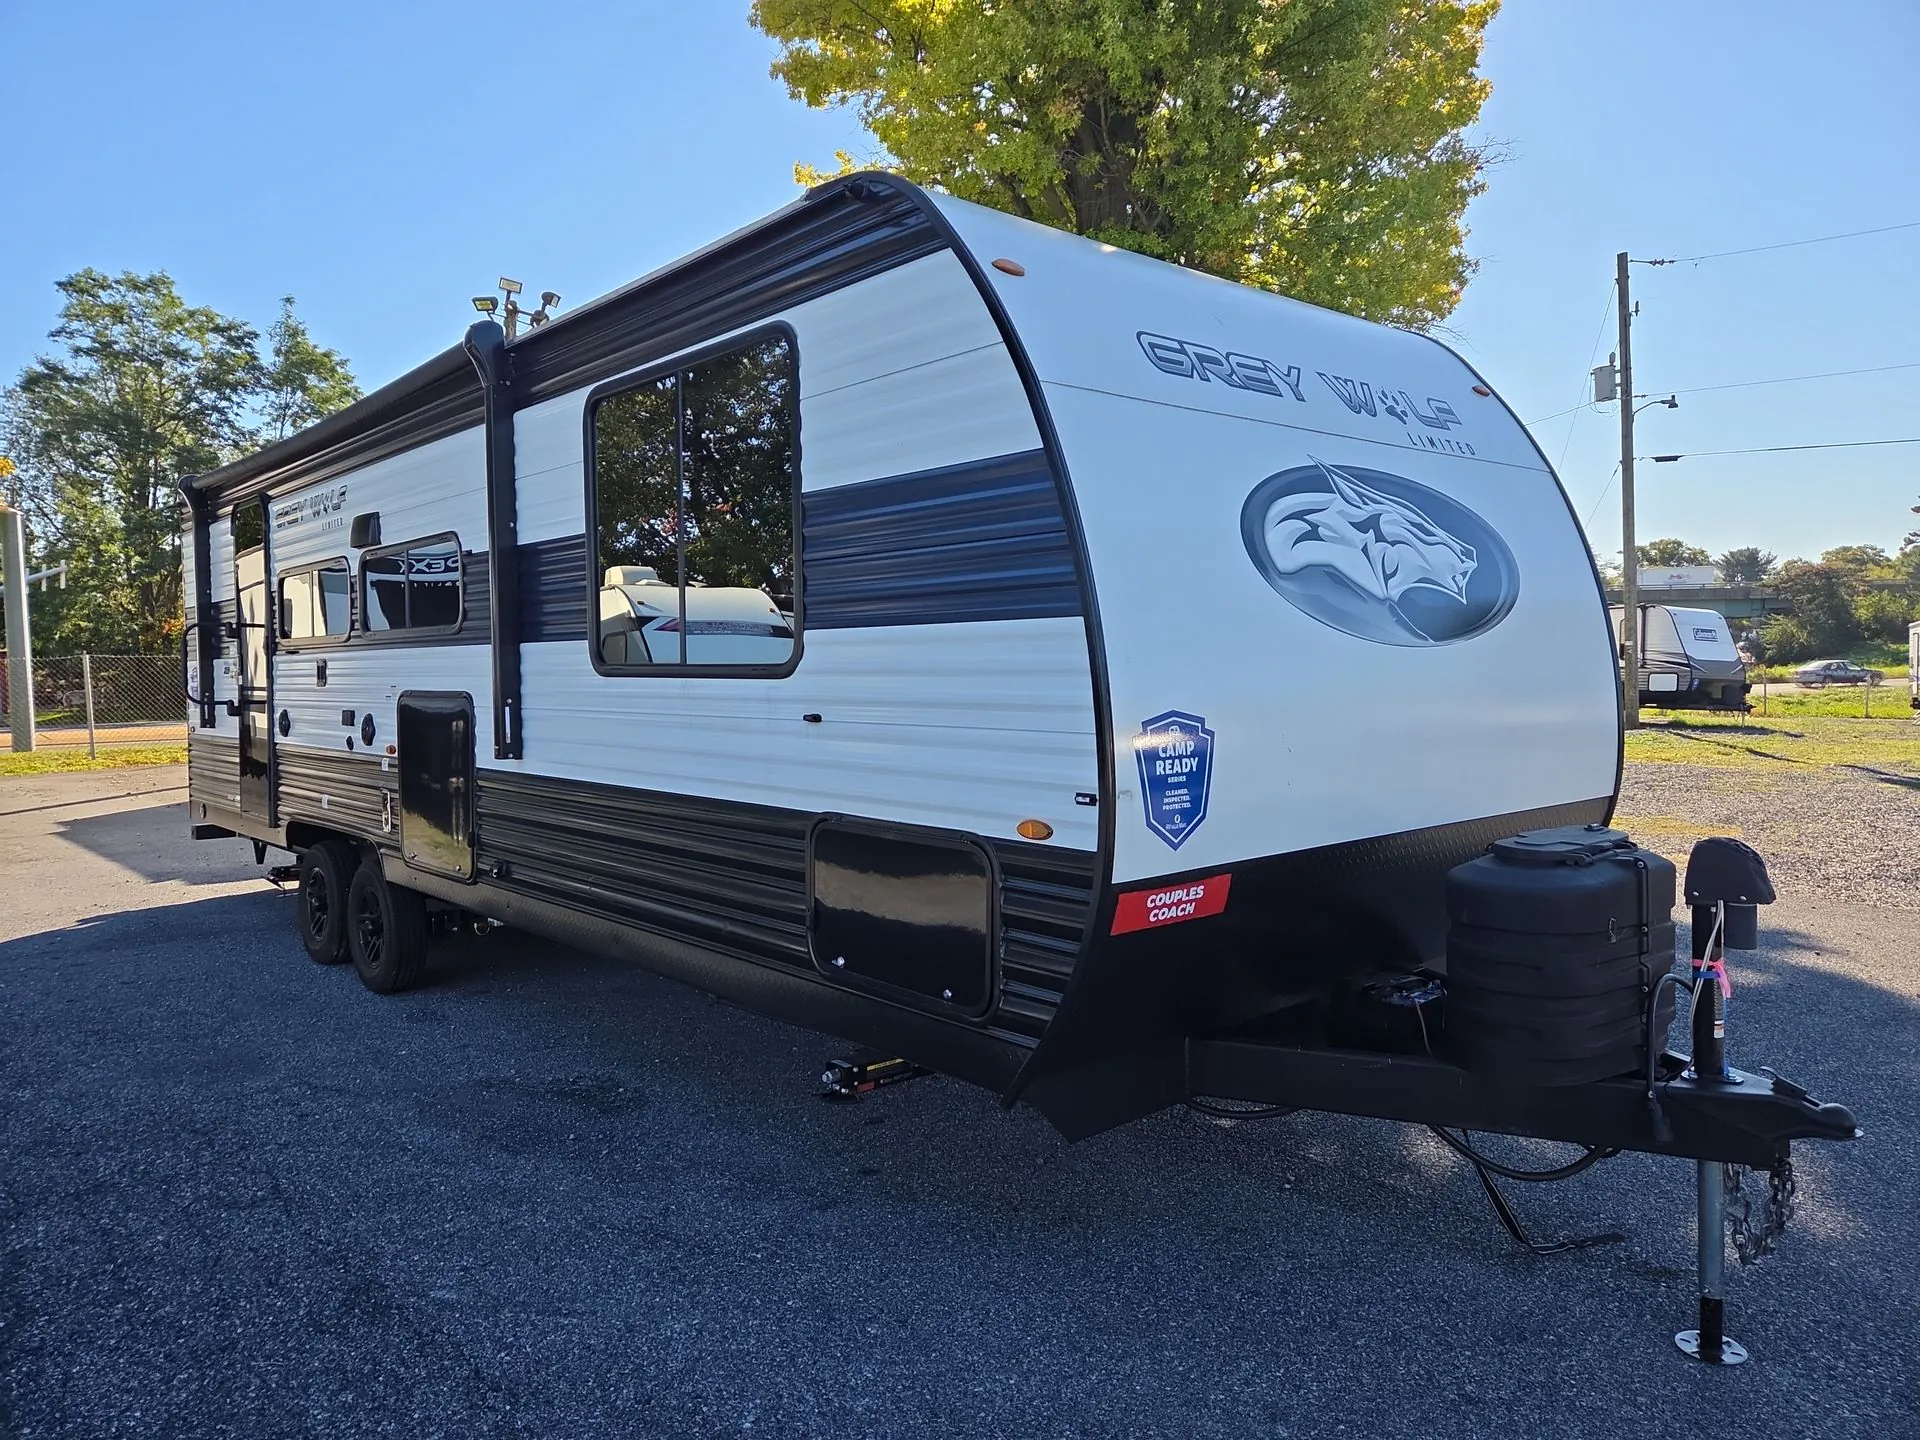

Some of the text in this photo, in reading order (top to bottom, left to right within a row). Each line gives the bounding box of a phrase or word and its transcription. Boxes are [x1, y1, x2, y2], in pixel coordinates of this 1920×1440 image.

[1136, 331, 1306, 402] GREY
[1409, 432, 1476, 456] LIMITED
[1158, 741, 1195, 757] CAMP
[1155, 757, 1199, 775] READY
[1146, 885, 1204, 908] COUPLES
[1149, 902, 1196, 922] COACH
